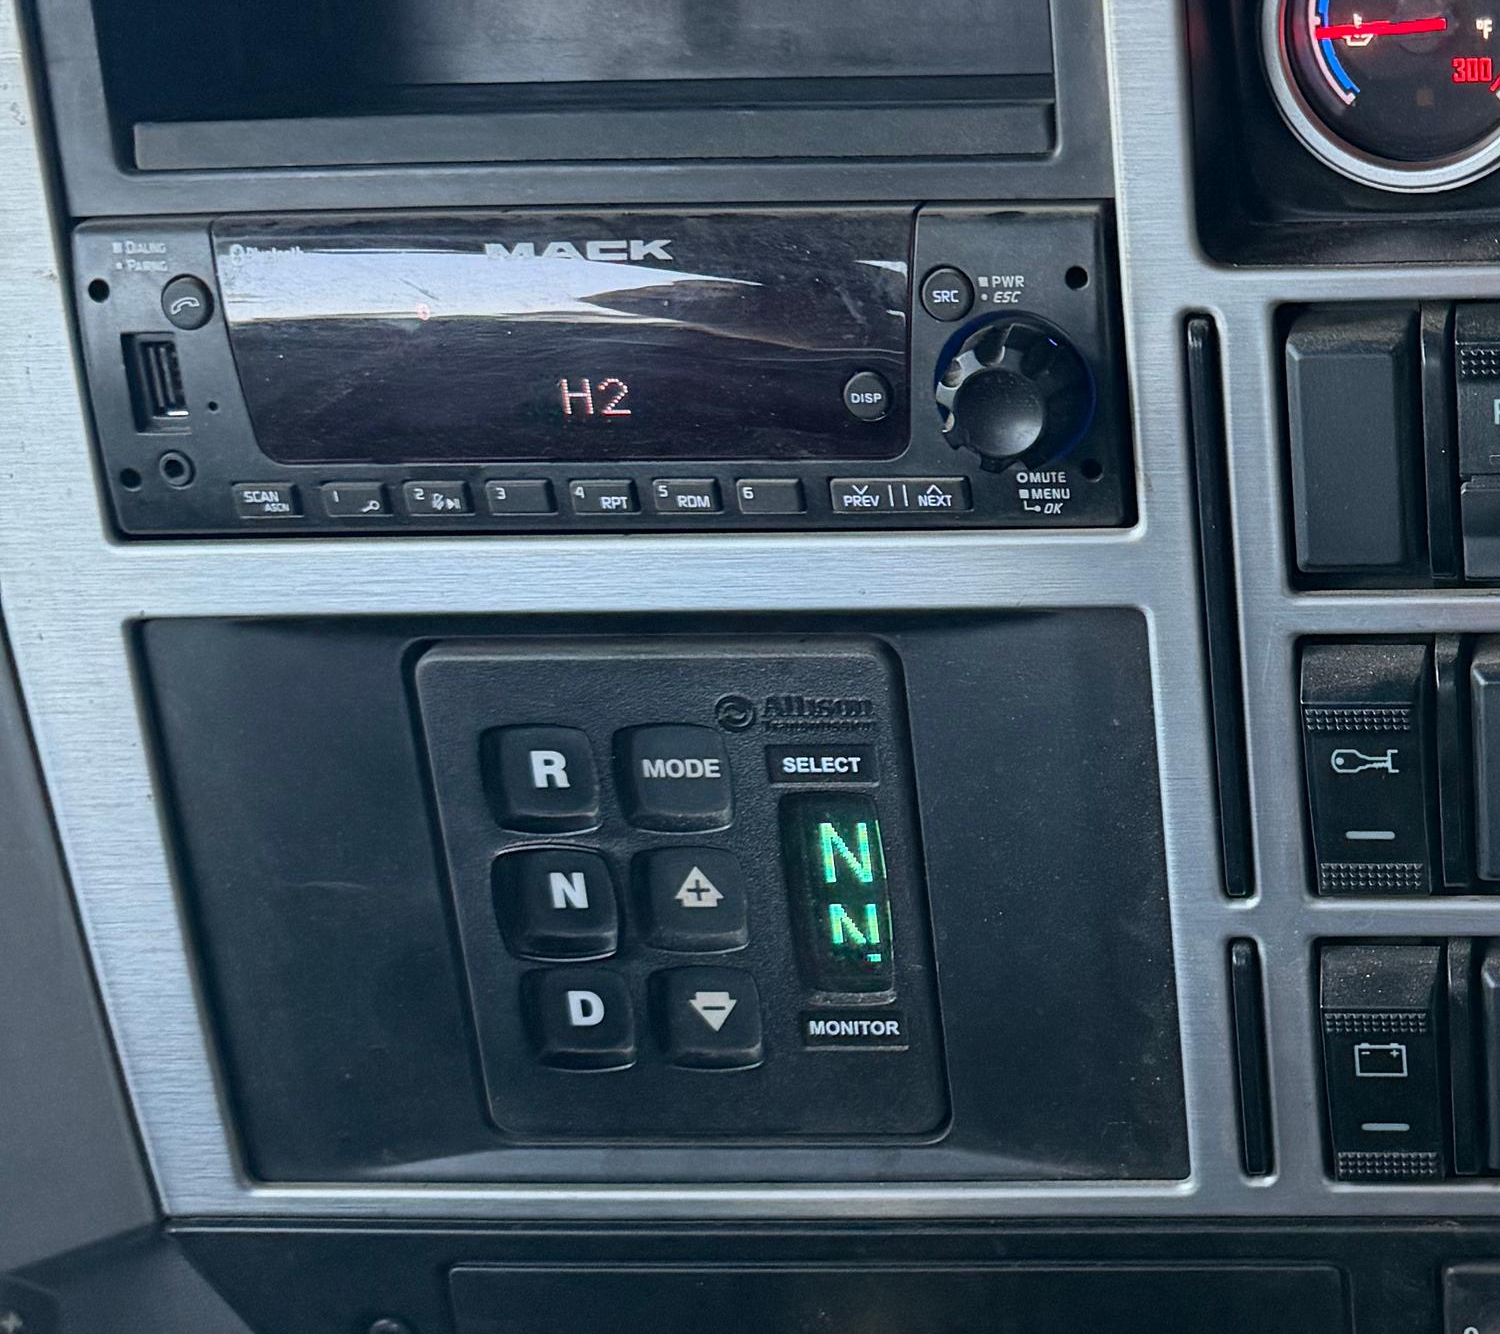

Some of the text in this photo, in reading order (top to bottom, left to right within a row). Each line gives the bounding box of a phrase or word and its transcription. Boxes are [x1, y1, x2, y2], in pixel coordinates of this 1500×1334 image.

[1452, 58, 1492, 84] 300
[484, 239, 674, 261] MACK
[992, 276, 1025, 288] PWR
[932, 290, 960, 303] SRC
[993, 291, 1021, 303] ESC
[561, 378, 632, 415] H2
[851, 393, 882, 404] DISP
[1030, 472, 1067, 484] MUTE
[244, 491, 279, 503] SCAN
[333, 491, 340, 502] 1
[414, 489, 425, 500] 2
[496, 488, 507, 500] 3
[574, 487, 585, 499] 4
[658, 485, 669, 498] 5
[743, 486, 754, 499] 6
[1032, 488, 1070, 499] MENU
[600, 496, 628, 509] RPT
[676, 495, 711, 508] RDM
[843, 495, 880, 507] PREV
[918, 495, 953, 507] NEXT
[1044, 503, 1064, 514] OK
[529, 750, 570, 788] R
[641, 758, 721, 778] MODE
[782, 757, 861, 773] SELECT
[819, 823, 873, 883] N
[550, 872, 589, 909] N
[829, 903, 880, 944] N
[567, 990, 605, 1026] D
[809, 1020, 900, 1036] MONITOR
